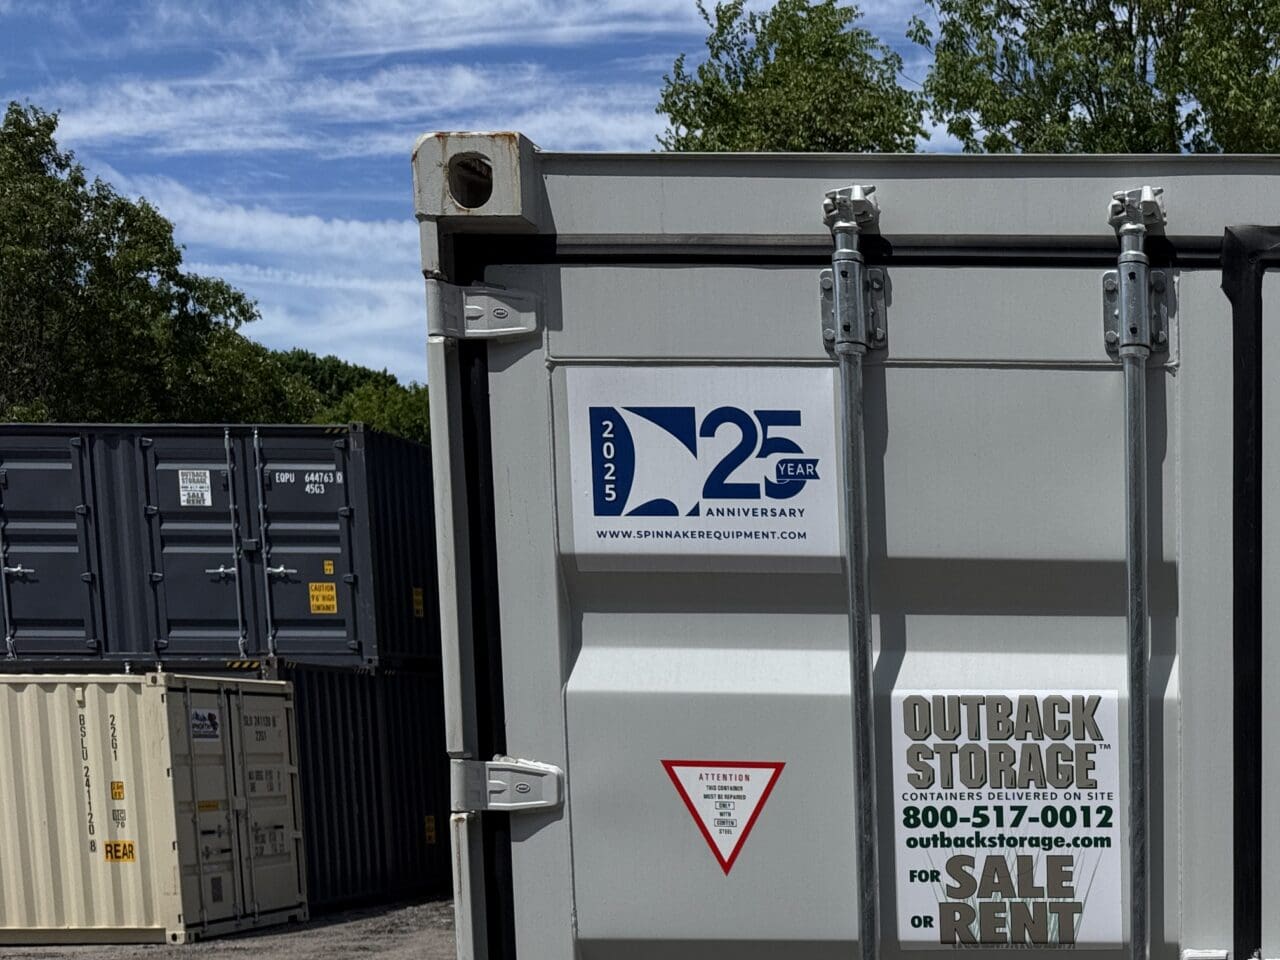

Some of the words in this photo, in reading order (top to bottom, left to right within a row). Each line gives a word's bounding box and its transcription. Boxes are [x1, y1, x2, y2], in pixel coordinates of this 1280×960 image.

[602, 420, 617, 501] 2025
[778, 463, 815, 476] YEAR
[305, 472, 334, 483] 644763
[305, 484, 325, 494] 45G3
[706, 507, 805, 518] ANNIVERSARY
[596, 530, 807, 540] WWW.SPINNAKEREQUIPMENT.COM
[903, 695, 1104, 741] OUTBACK
[109, 714, 118, 761] 22G1
[906, 743, 1097, 789] STORAGE
[699, 773, 750, 782] ATTENTION
[84, 766, 95, 835] 241120
[902, 792, 983, 801] CONTAINERS
[988, 792, 1058, 800] DELIVERED
[1064, 792, 1082, 800] ON
[1087, 792, 1114, 800] SITE
[903, 805, 1113, 828] 800-517-0012
[906, 831, 1111, 850] outbackstorage.com
[104, 843, 134, 859] REAR
[909, 870, 941, 882] FOR
[945, 855, 1075, 899] SALE
[911, 915, 934, 928] OR
[939, 902, 1082, 944] RENT
